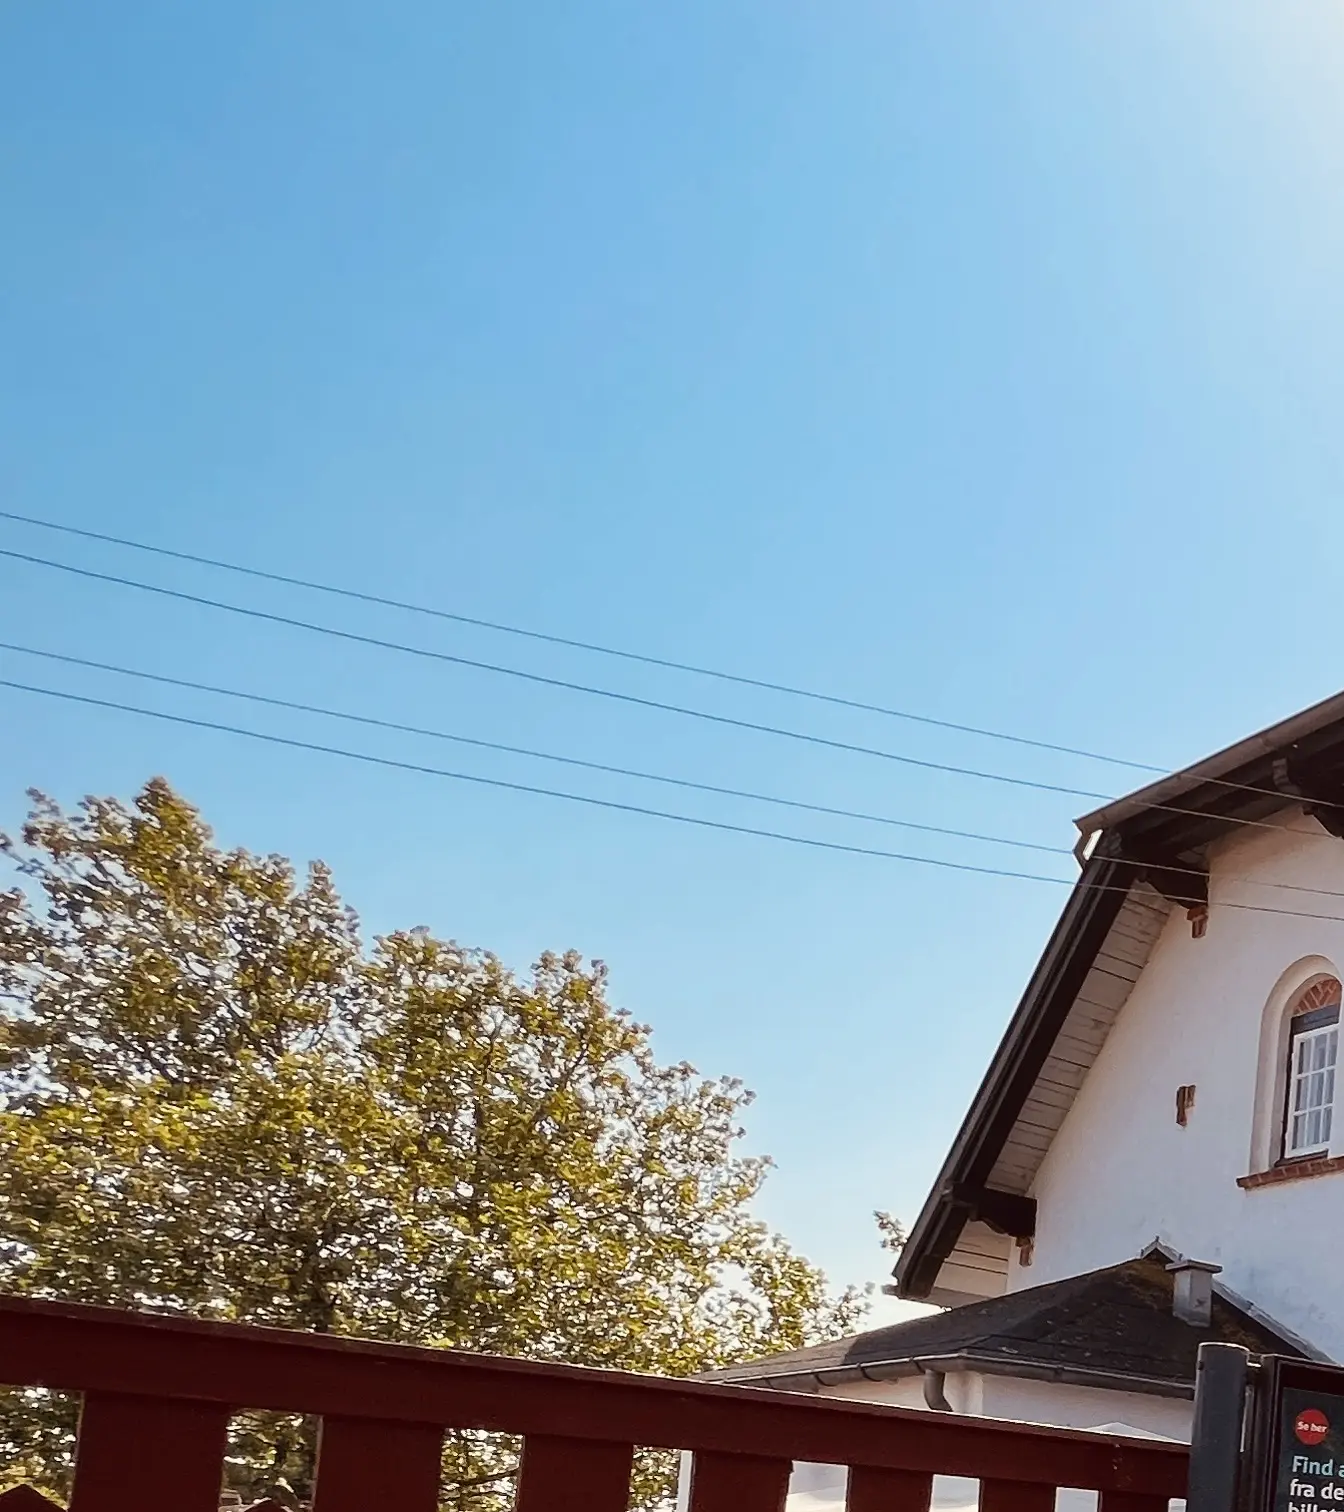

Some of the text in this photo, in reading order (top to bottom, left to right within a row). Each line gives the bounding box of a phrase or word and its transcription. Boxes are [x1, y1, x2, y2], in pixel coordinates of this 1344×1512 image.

[1297, 1421, 1309, 1431] Se
[1291, 1455, 1334, 1476] Find
[1289, 1478, 1315, 1498] fra
